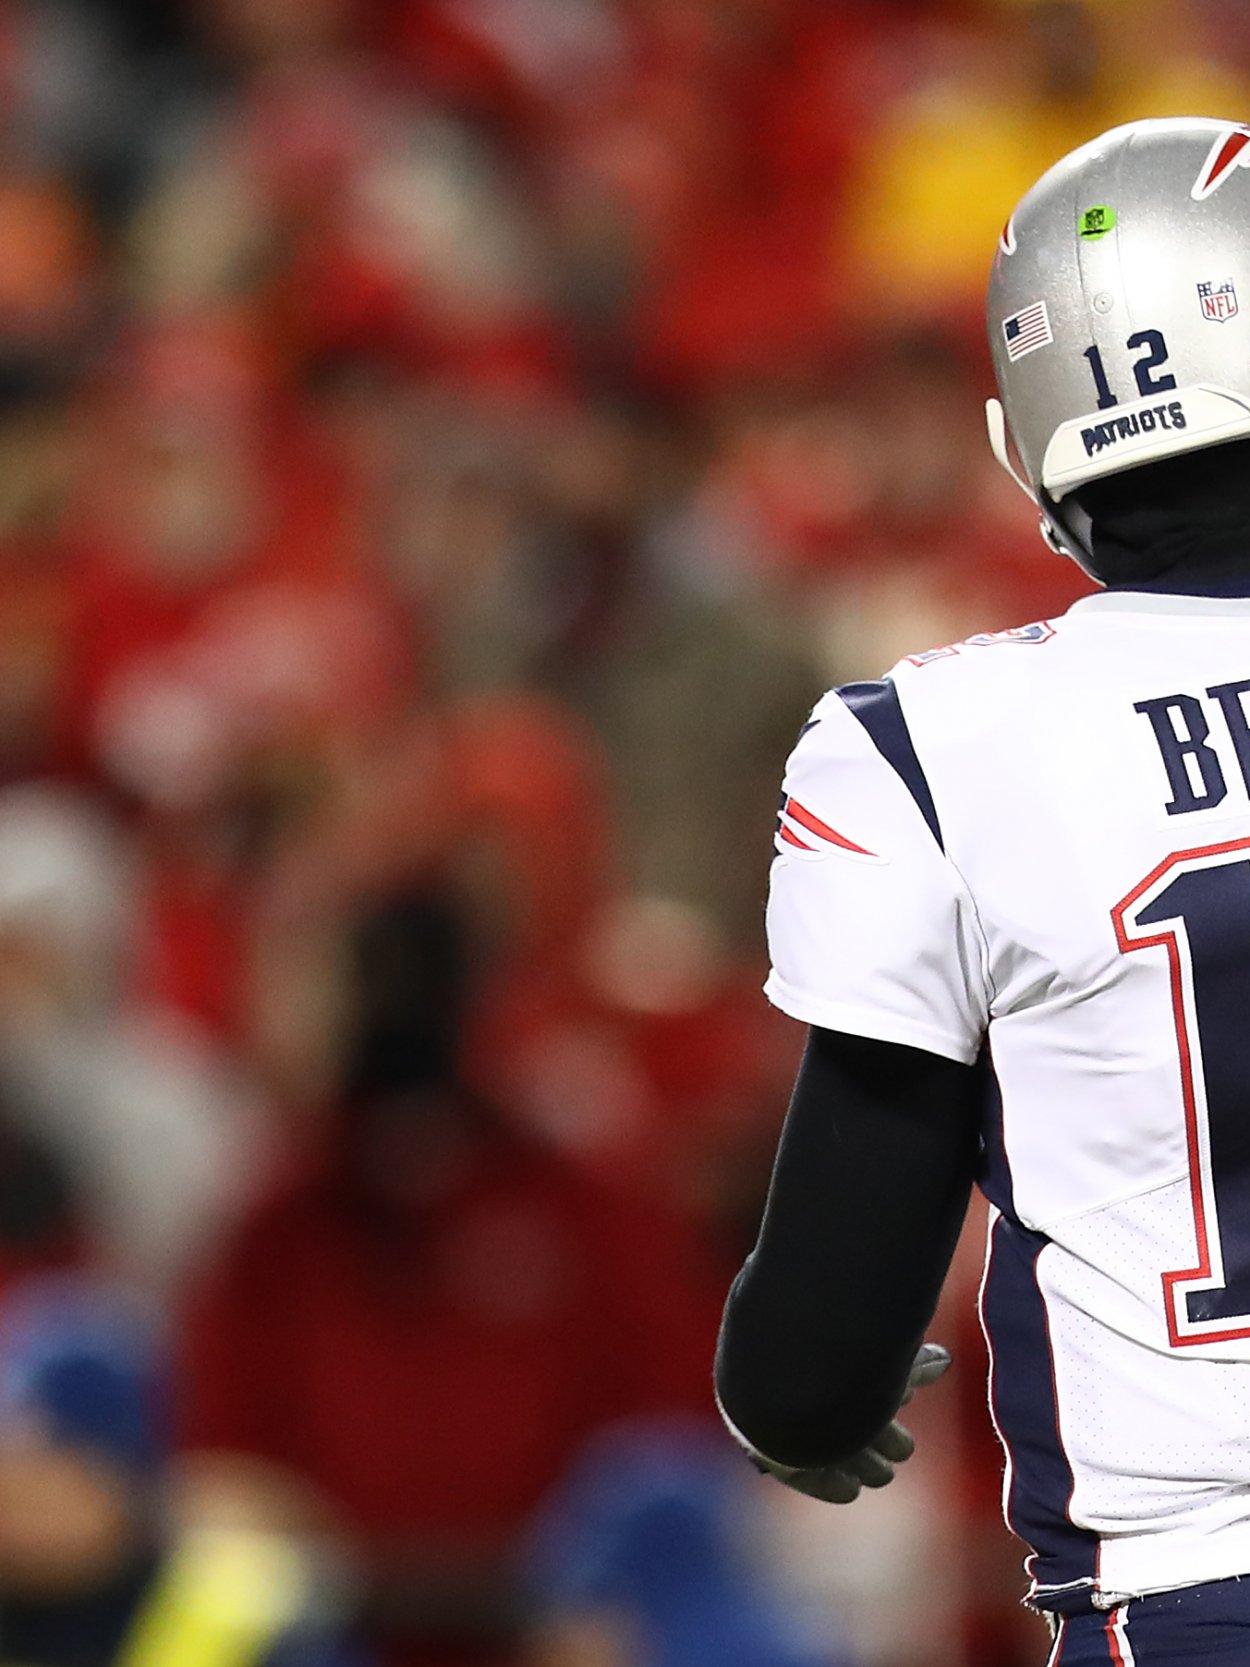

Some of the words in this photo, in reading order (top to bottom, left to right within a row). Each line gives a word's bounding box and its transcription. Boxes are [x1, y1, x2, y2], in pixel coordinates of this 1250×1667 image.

[1203, 294, 1235, 318] NFL
[1083, 328, 1177, 410] 12
[1080, 401, 1187, 458] PATRIOTS
